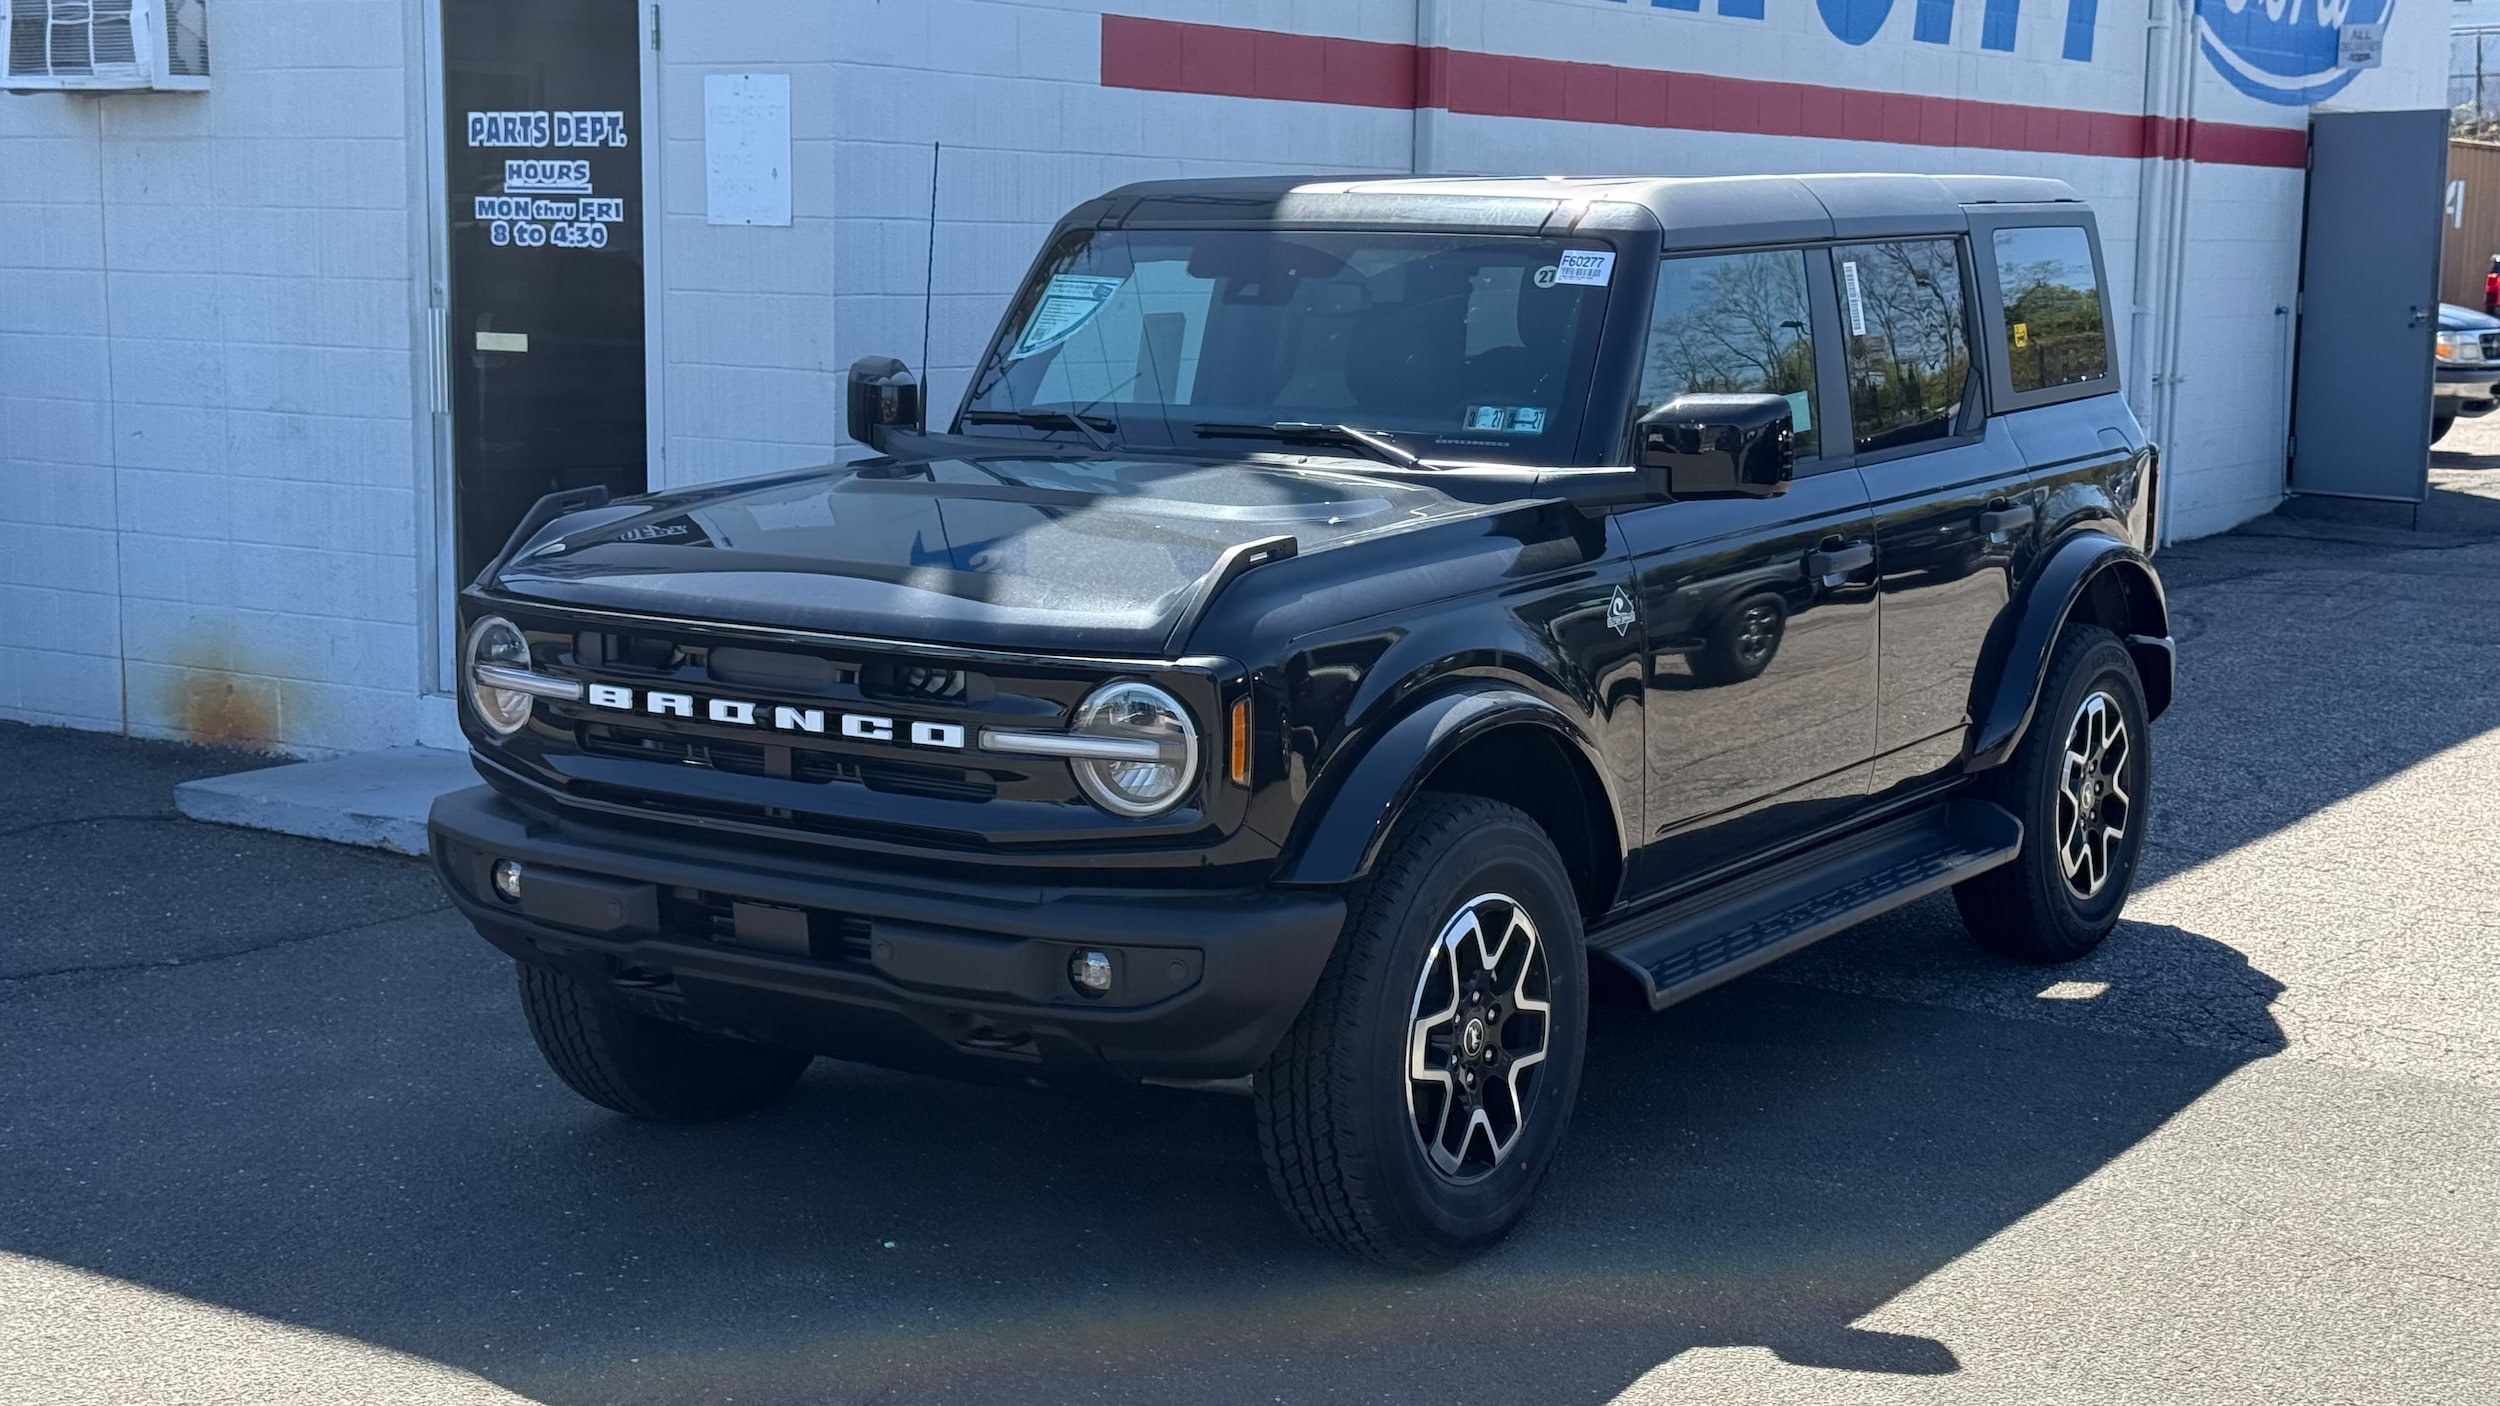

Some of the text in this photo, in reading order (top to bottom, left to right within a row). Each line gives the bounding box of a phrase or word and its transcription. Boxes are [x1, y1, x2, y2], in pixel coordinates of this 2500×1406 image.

[469, 112, 626, 146] PARTS DEPT.
[506, 161, 589, 183] HOURS
[476, 198, 622, 221] MON thru FRI
[492, 222, 606, 246] 8 to 4:30
[1562, 255, 1605, 268] F60277
[589, 683, 965, 750] BRONCO
